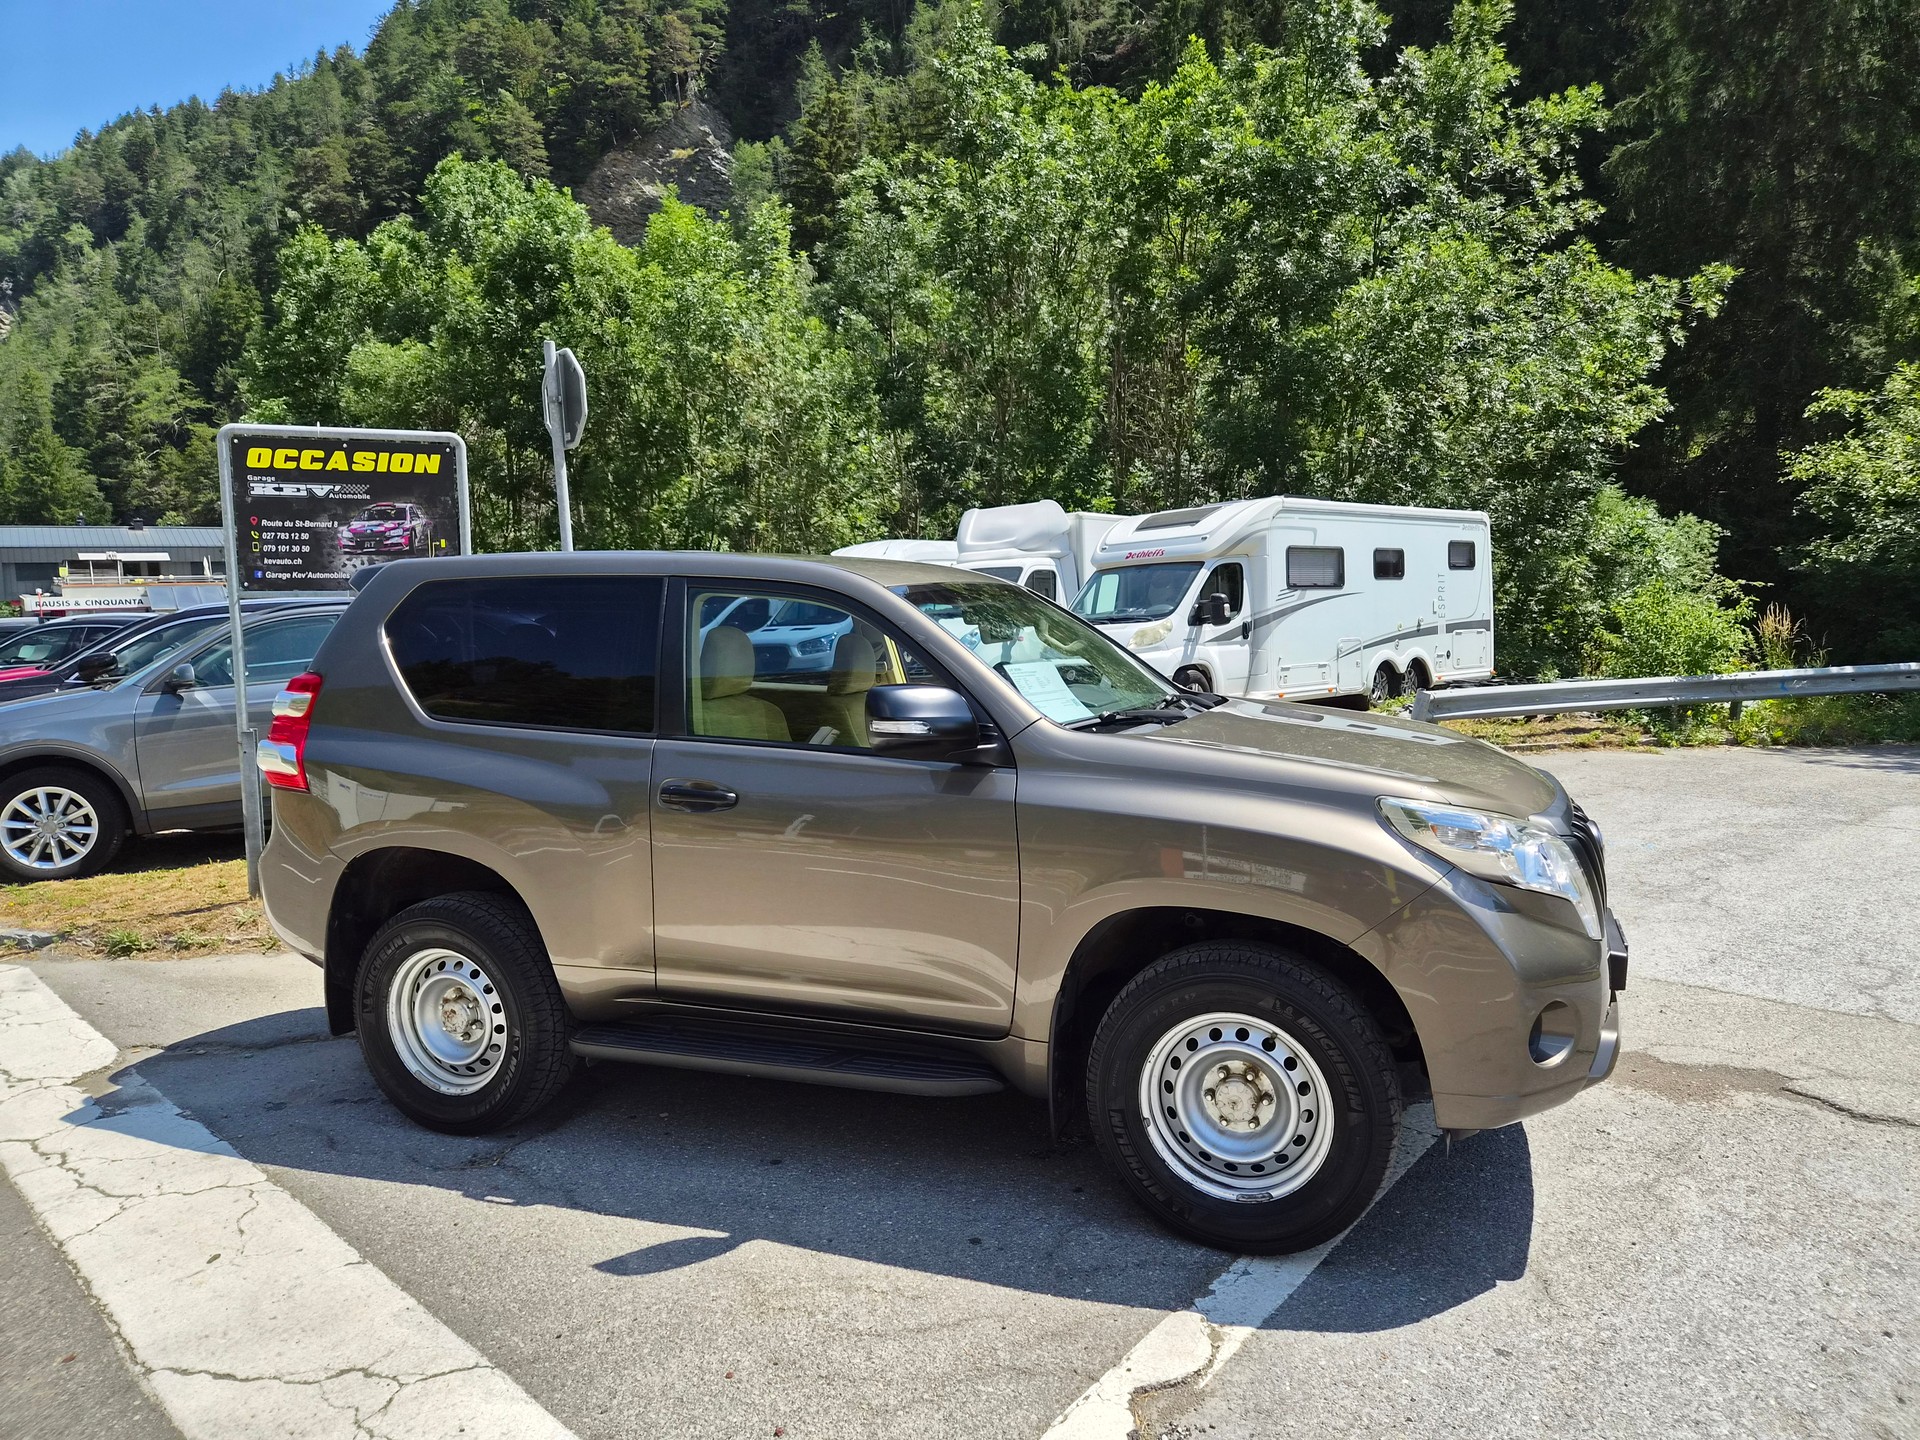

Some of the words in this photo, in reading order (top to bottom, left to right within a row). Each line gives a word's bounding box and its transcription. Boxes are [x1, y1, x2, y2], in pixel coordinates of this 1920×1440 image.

[246, 447, 441, 474] OCCASION
[328, 492, 371, 500] Automobile
[261, 519, 283, 527] Route
[284, 519, 293, 527] du
[294, 520, 333, 528] St-Bernard
[277, 532, 289, 540] 783
[291, 545, 300, 553] 30
[301, 545, 311, 553] 50
[263, 557, 303, 565] kevauto.ch
[265, 571, 291, 580] Garage
[1437, 573, 1446, 619] ESPRIT
[35, 599, 71, 608] RAUSIS
[85, 598, 145, 607] CINQUANTA
[363, 934, 404, 996] MICHELIN
[1295, 1015, 1364, 1111] MICHELIN
[1108, 1110, 1169, 1202] MICHELIN
